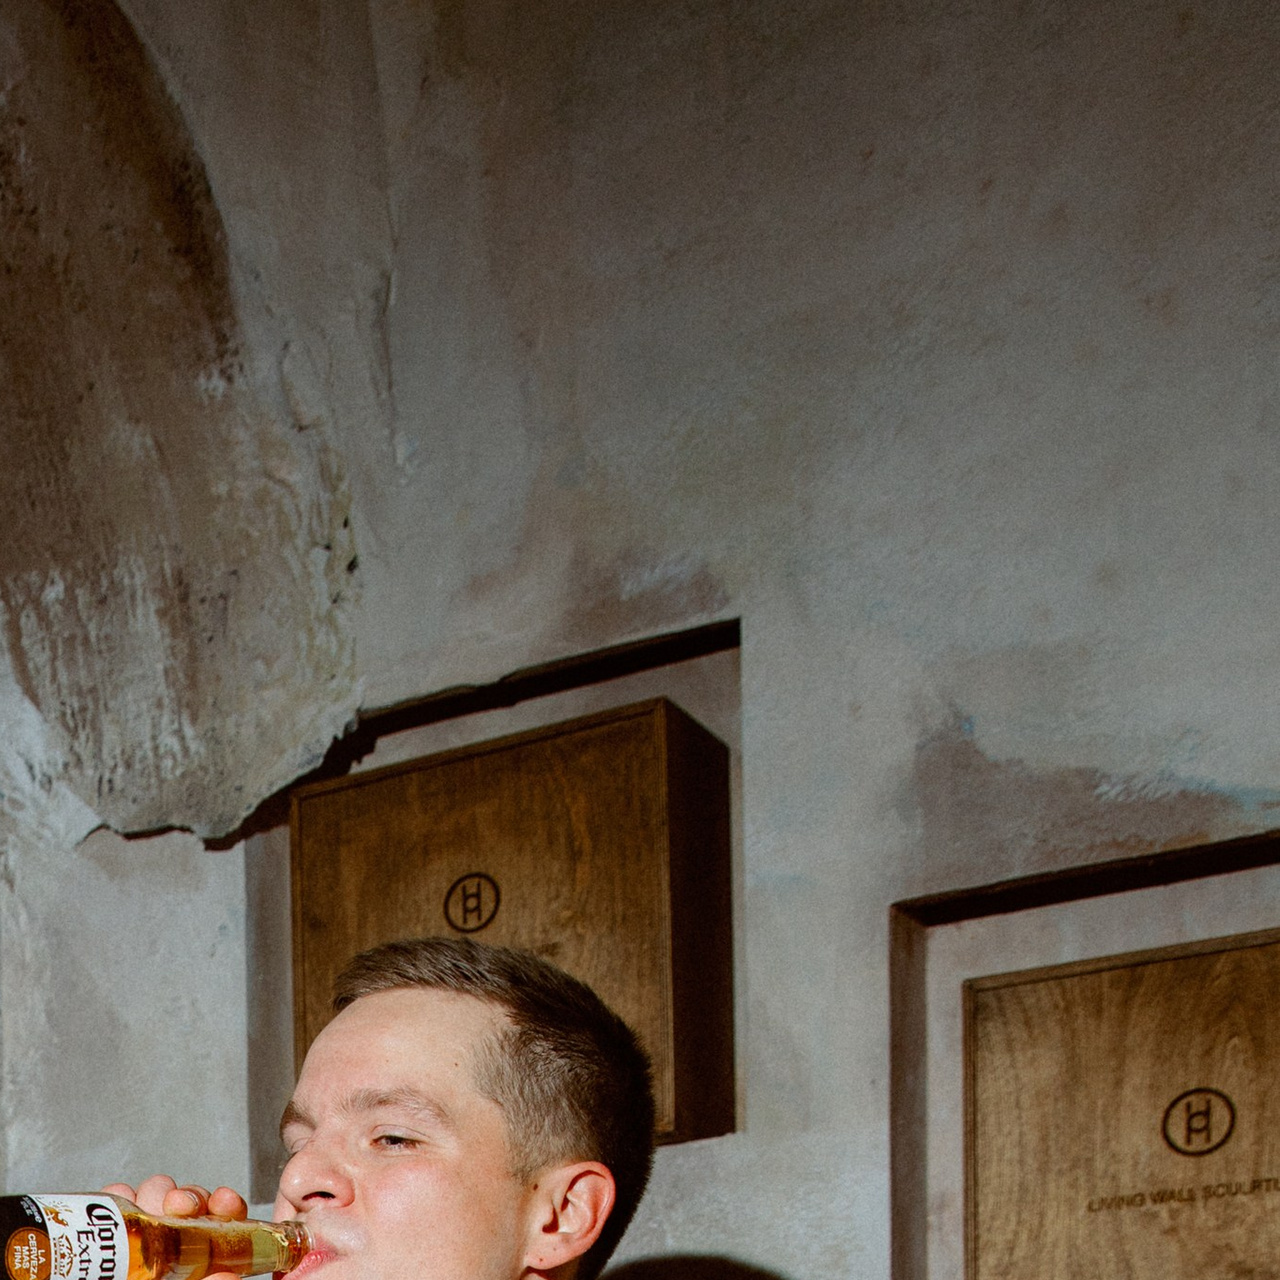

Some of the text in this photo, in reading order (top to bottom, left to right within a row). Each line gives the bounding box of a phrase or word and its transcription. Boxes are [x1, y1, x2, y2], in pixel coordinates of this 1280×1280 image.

[22, 1246, 30, 1269] MAS
[28, 1233, 38, 1280] CERVEZA
[38, 1249, 46, 1264] LA
